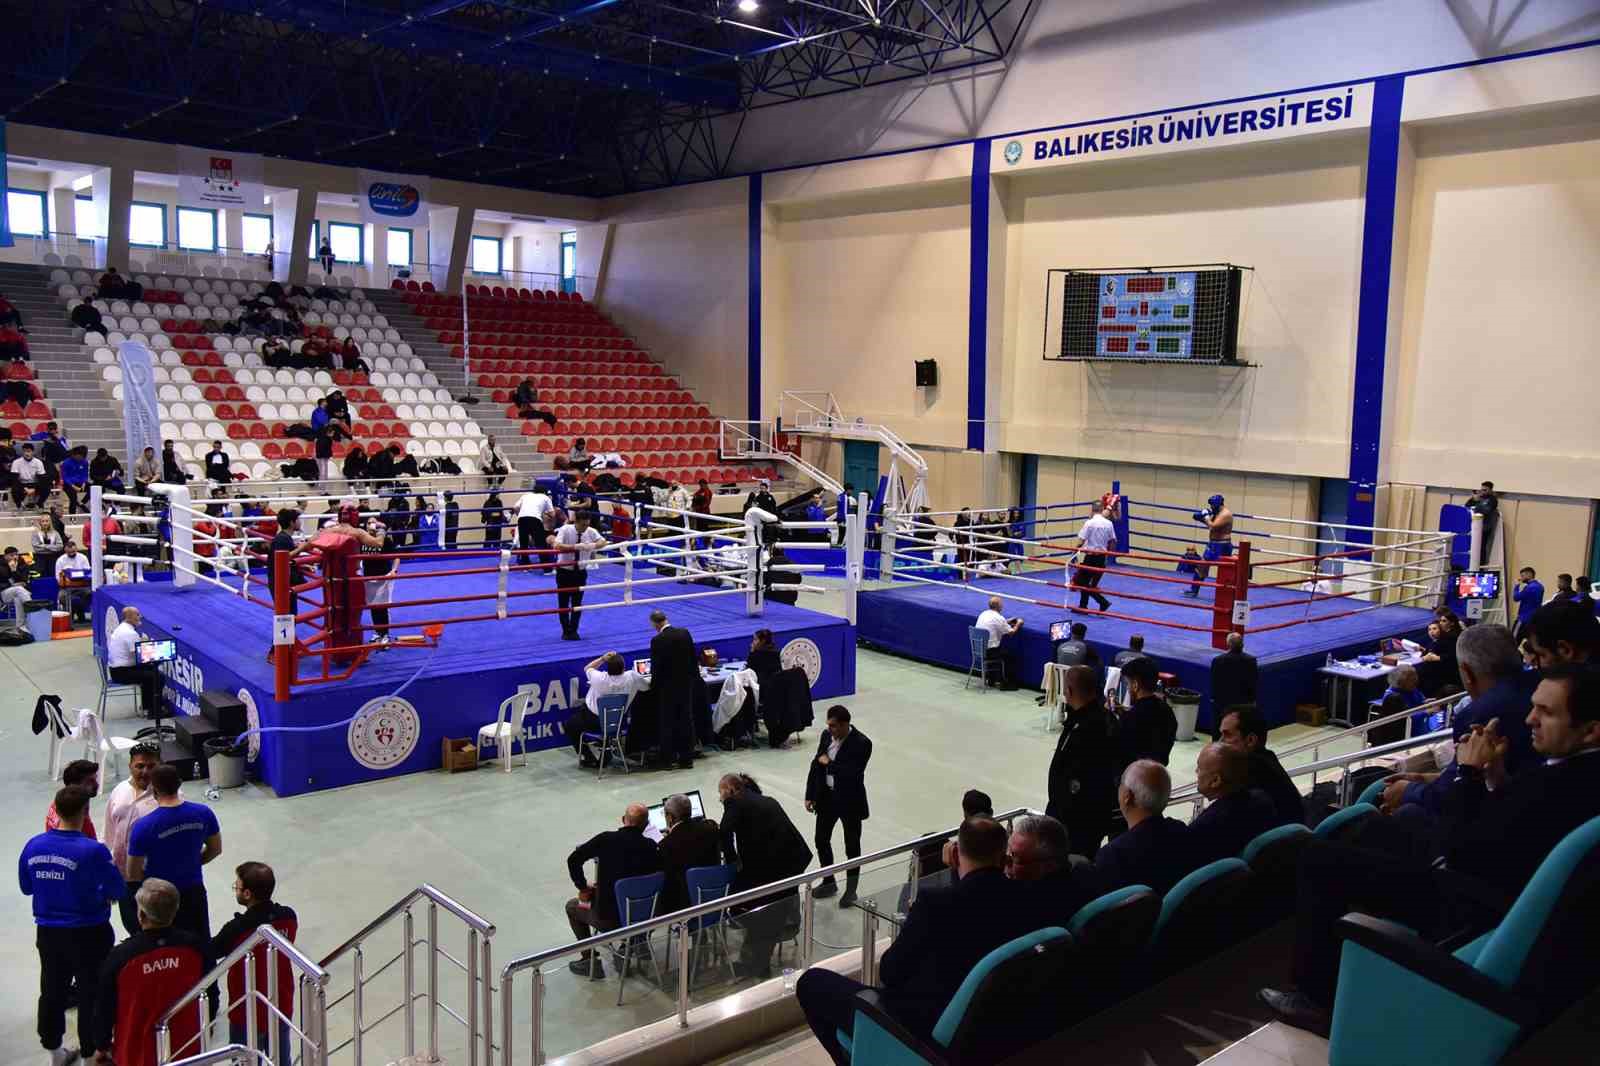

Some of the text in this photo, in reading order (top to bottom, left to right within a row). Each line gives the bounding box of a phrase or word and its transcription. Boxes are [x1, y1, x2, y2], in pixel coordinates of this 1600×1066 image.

[1034, 88, 1353, 160] BALIKESİR ÜNİVERSİTESİ
[280, 628, 287, 639] 1
[163, 654, 203, 696] KESİR
[517, 676, 586, 716] BAL
[35, 869, 65, 880] DENİZLİ
[143, 957, 179, 974] BAUN
